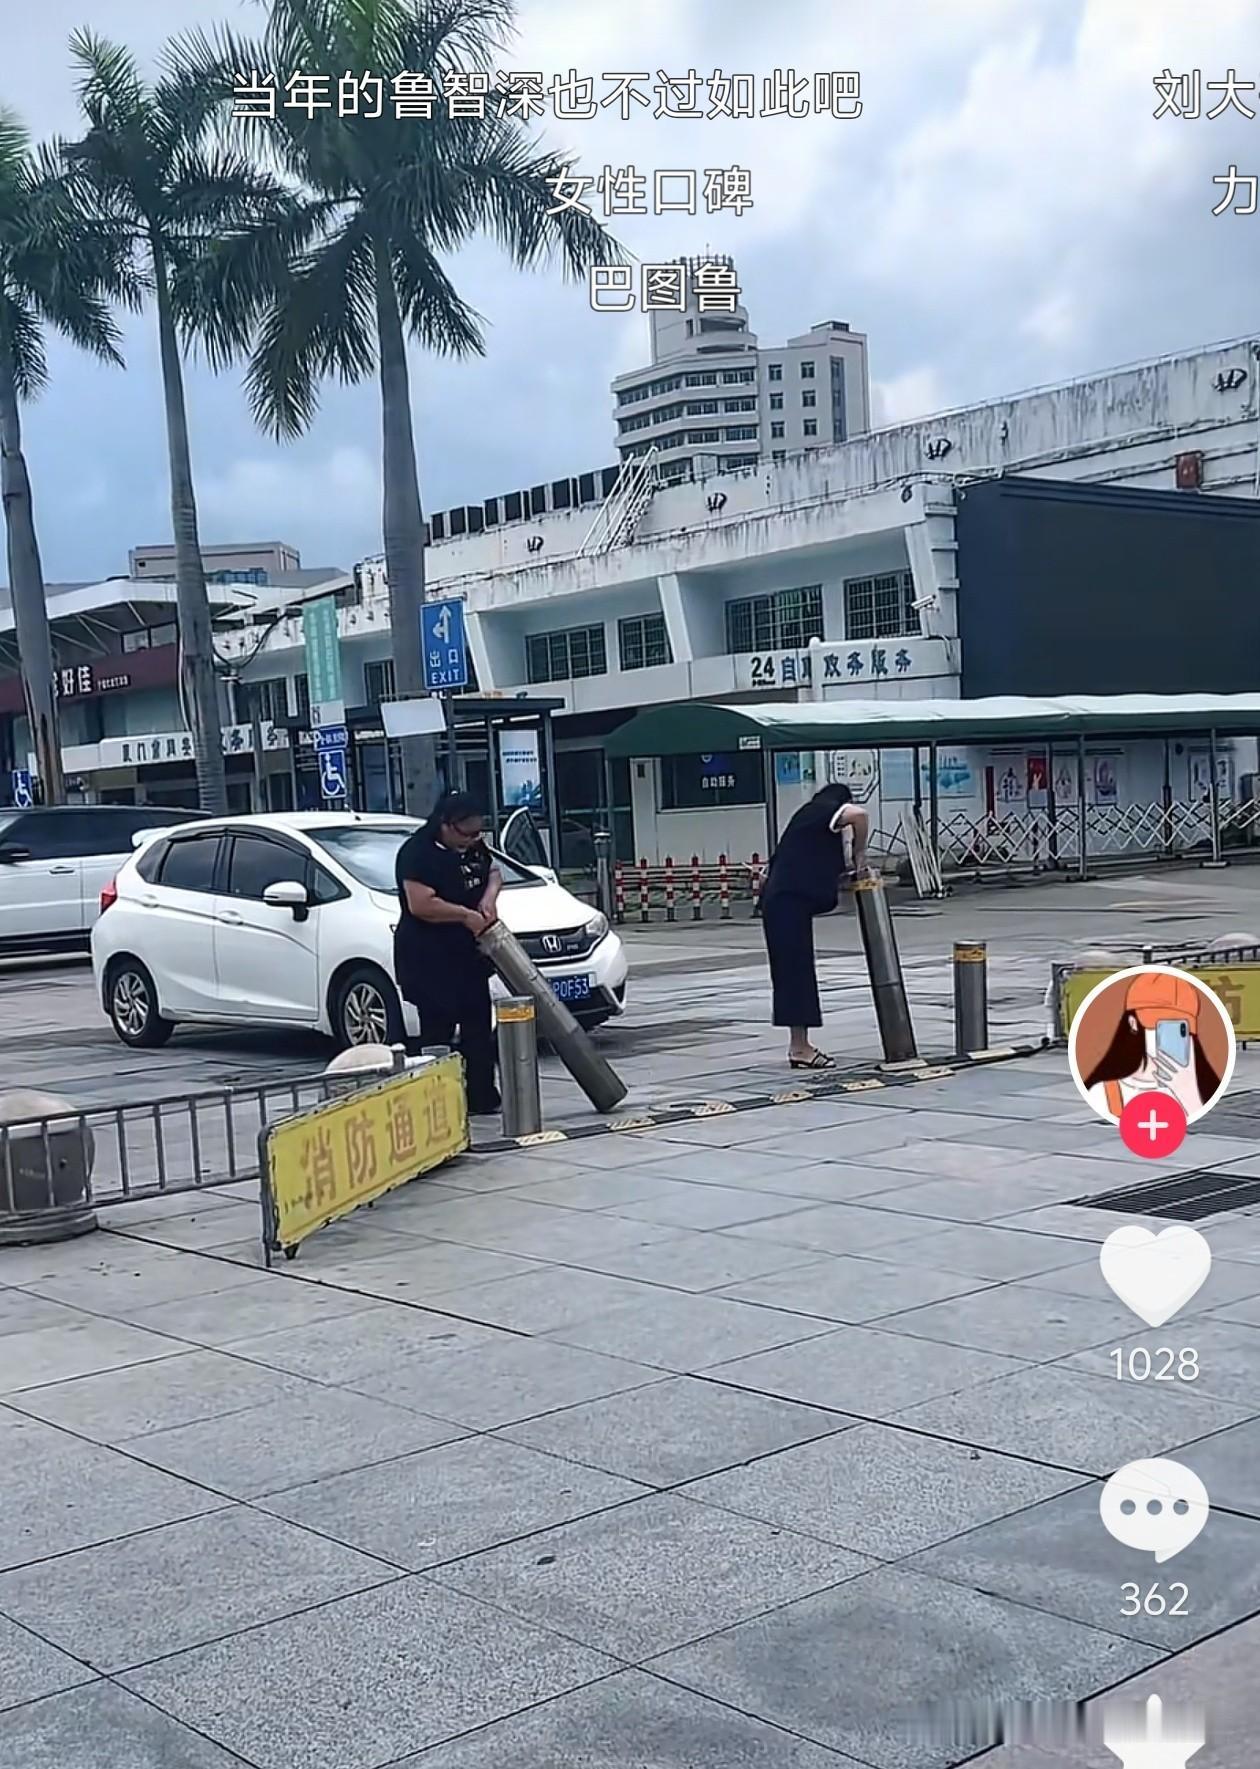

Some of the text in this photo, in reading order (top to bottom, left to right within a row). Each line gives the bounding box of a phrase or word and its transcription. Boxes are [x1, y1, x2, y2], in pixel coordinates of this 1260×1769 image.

[430, 648, 459, 667] 出口
[751, 656, 775, 678] 24
[431, 668, 460, 684] EXIT
[301, 1074, 452, 1211] 消防通道
